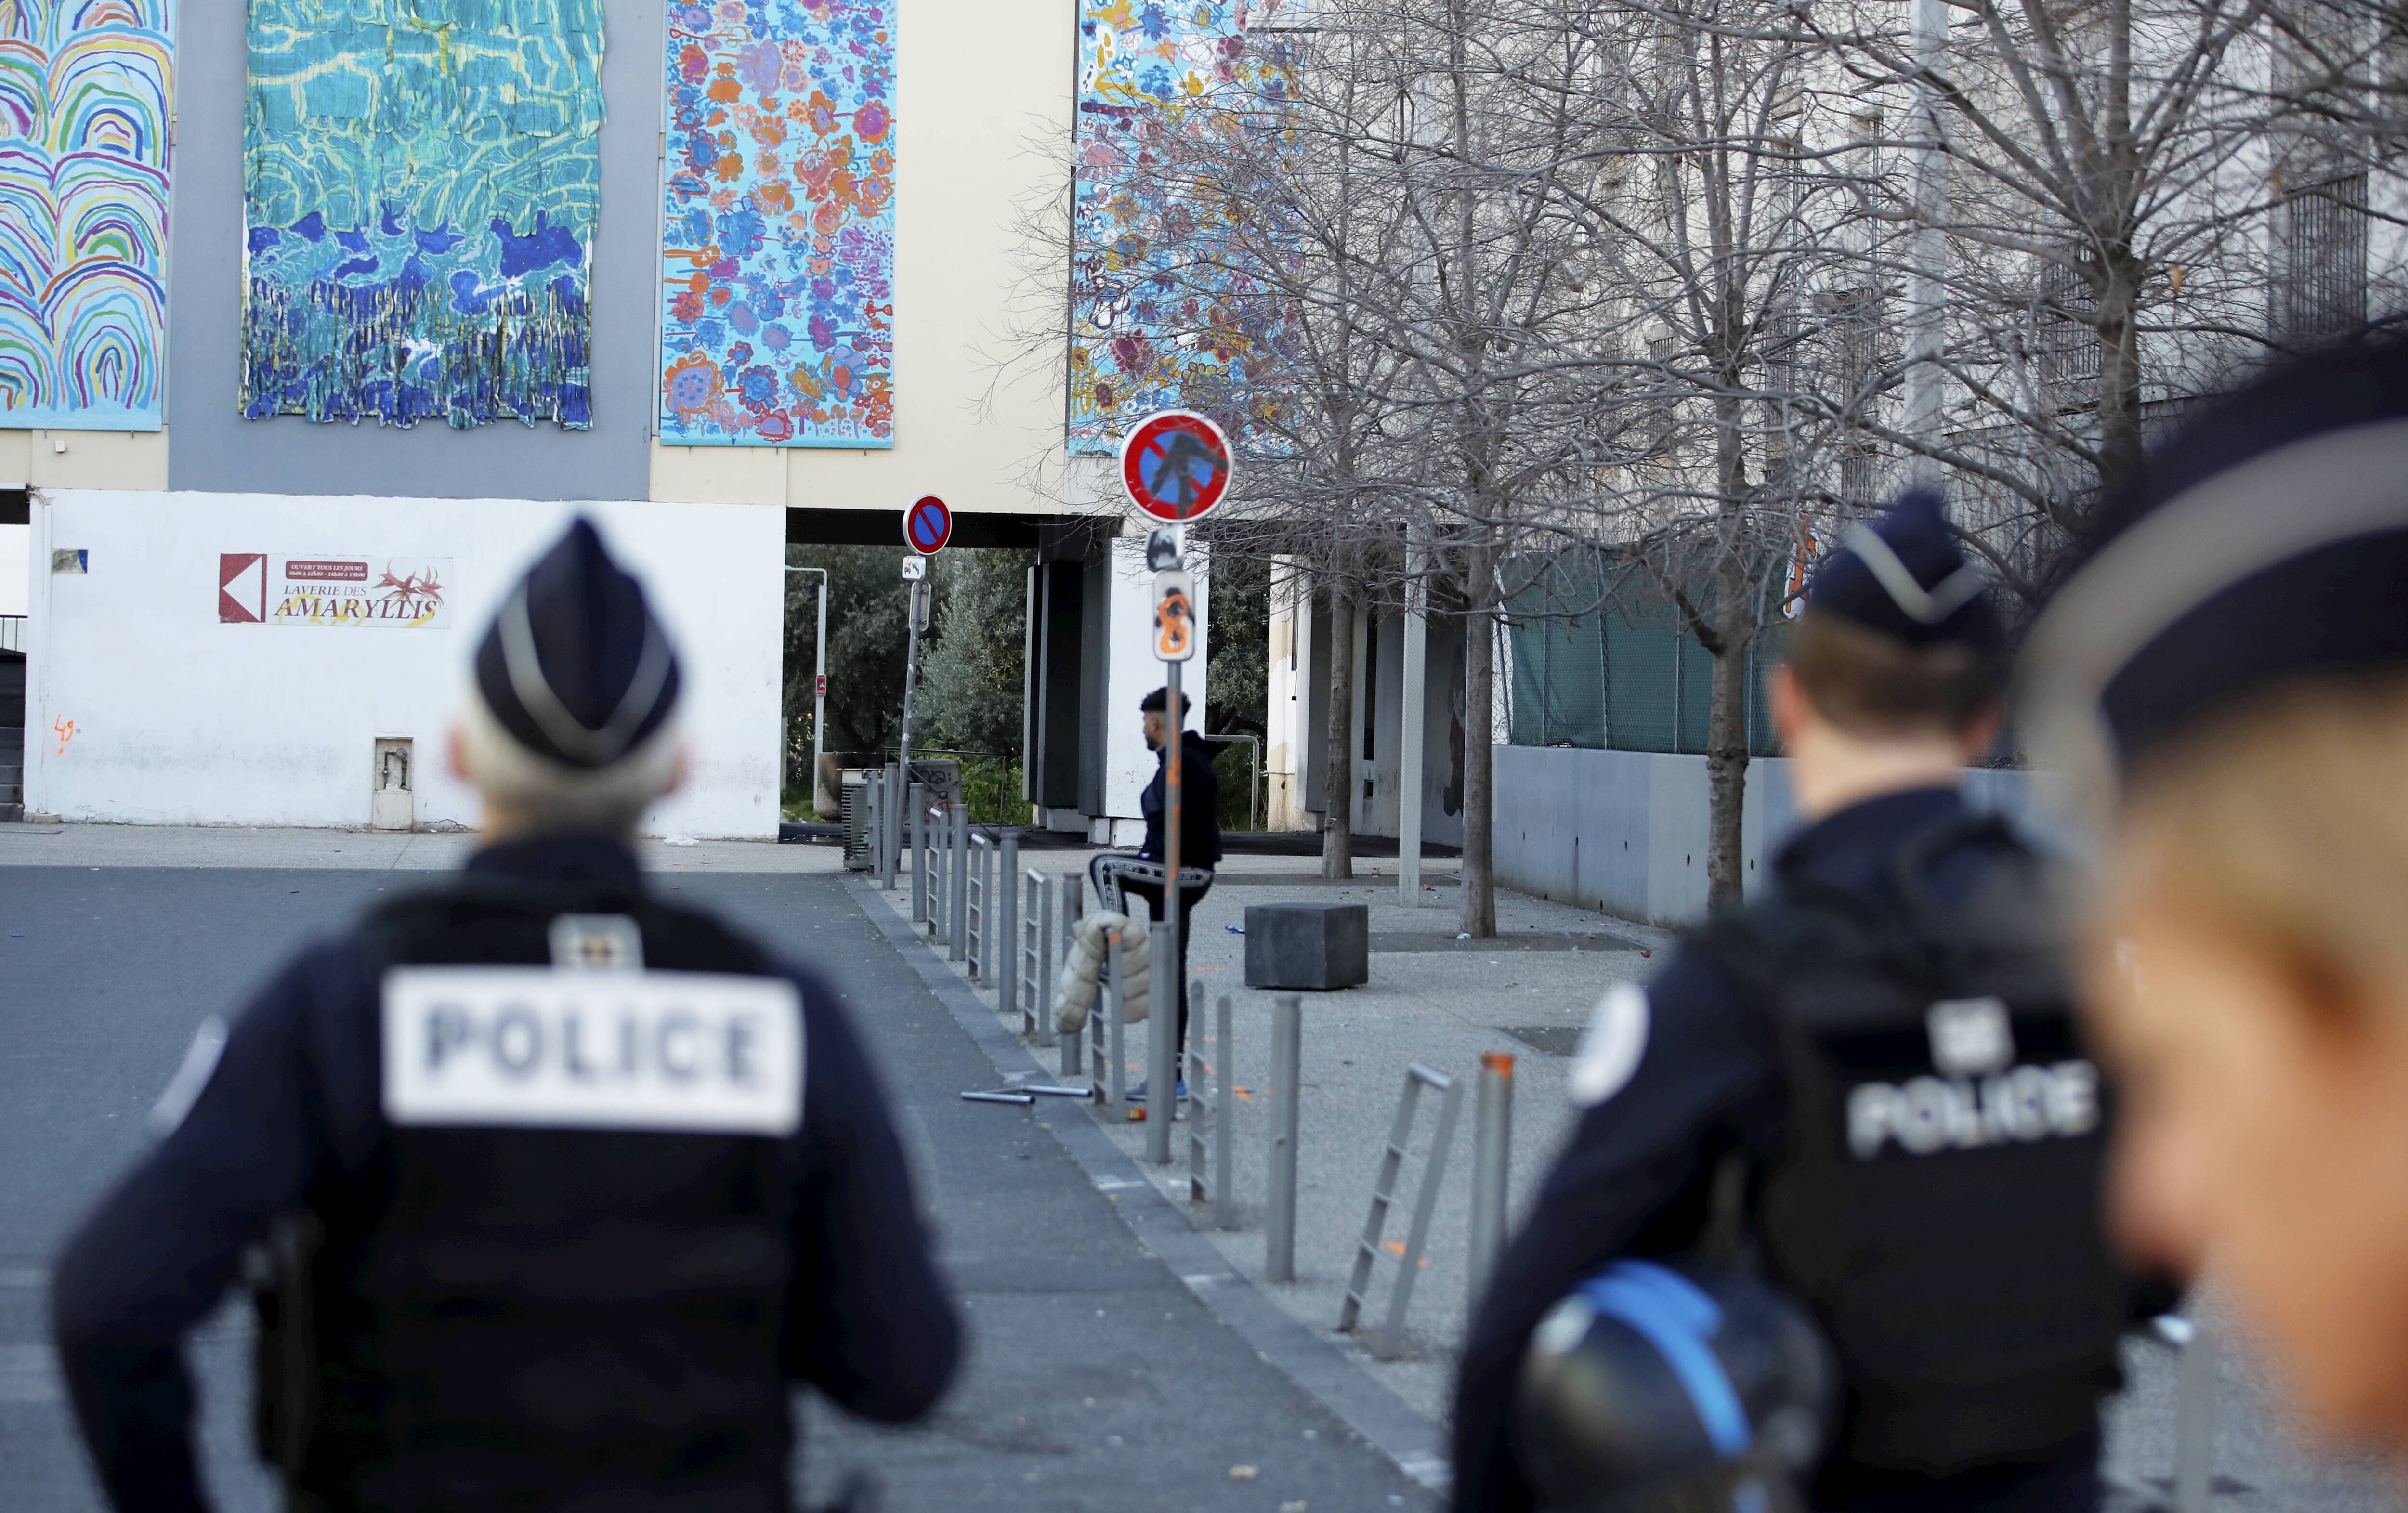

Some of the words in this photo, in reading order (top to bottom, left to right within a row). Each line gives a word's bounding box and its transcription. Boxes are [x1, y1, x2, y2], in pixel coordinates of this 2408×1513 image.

[273, 598, 437, 620] AMARYLLIS
[284, 585, 340, 596] LAVERIE
[344, 586, 367, 596] DES
[422, 1003, 769, 1090] POLICE
[1846, 1059, 2100, 1161] POLICE
